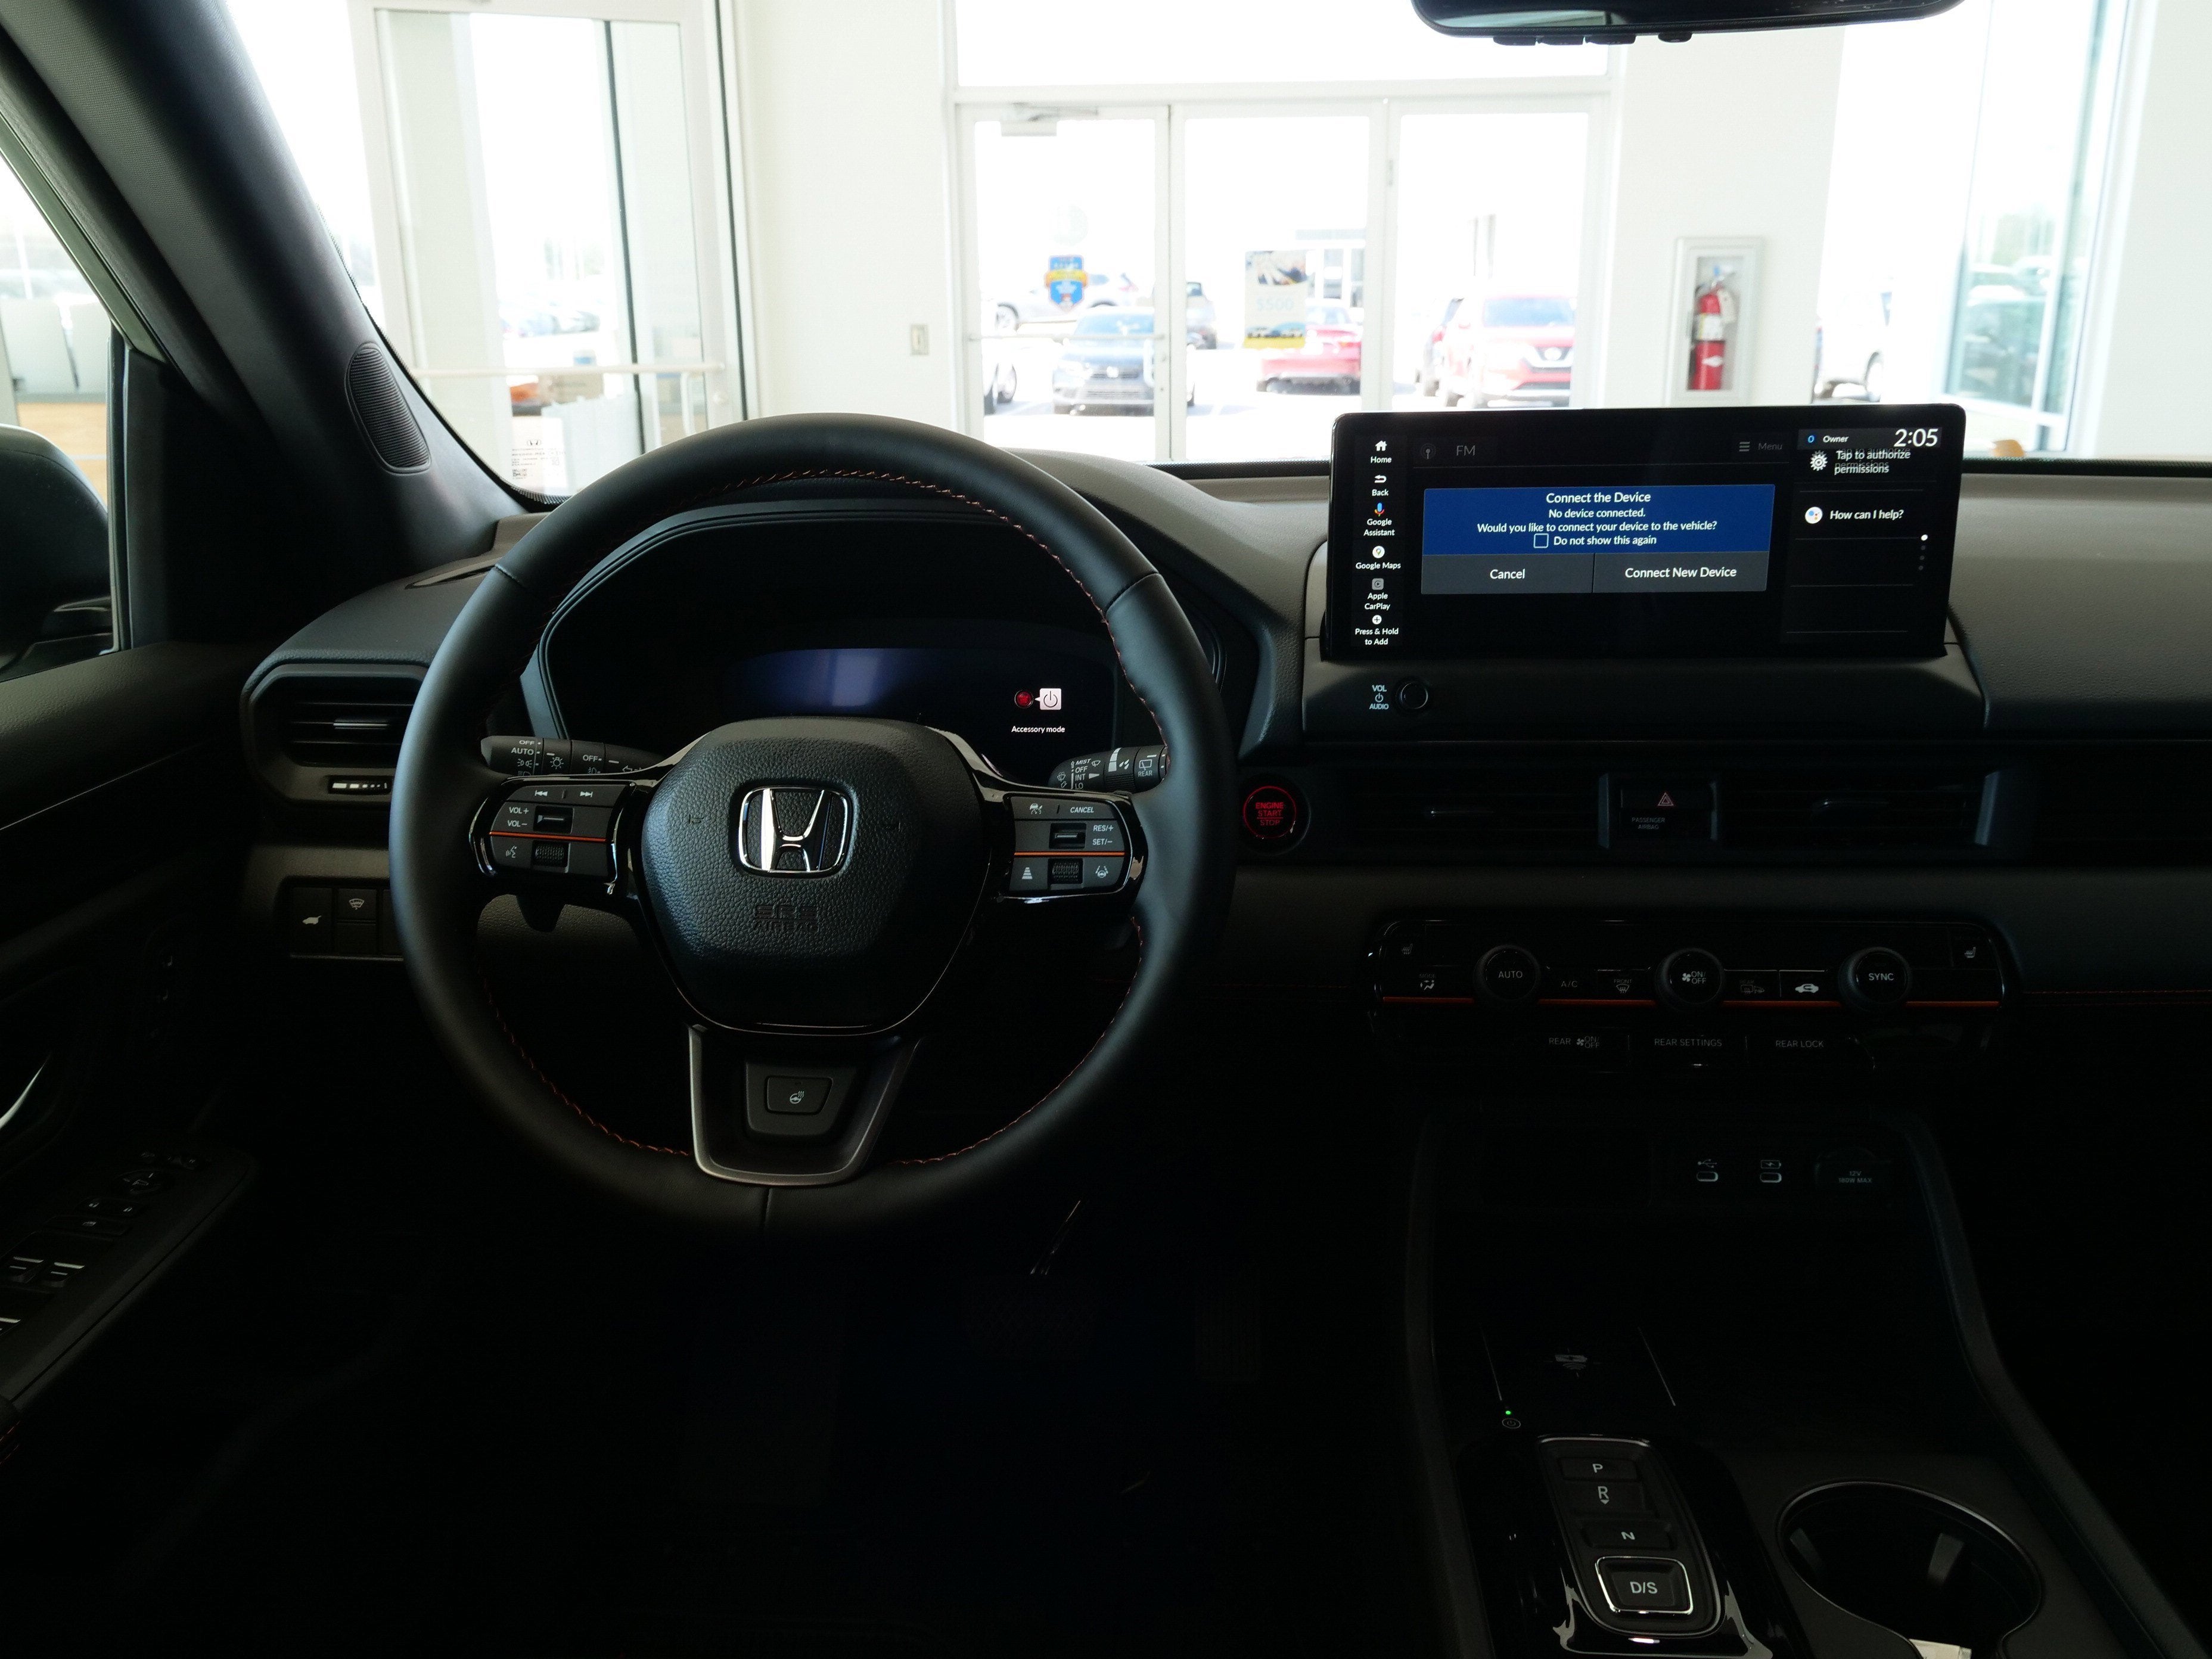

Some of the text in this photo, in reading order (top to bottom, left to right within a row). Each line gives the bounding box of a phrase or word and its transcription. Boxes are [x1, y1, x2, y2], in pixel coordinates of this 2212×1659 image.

[1894, 428, 1938, 447] 2:05
[1456, 445, 1475, 456] FM
[1758, 442, 1783, 451] Menu
[1836, 450, 1911, 461] Tap to authorize
[1834, 465, 1890, 476] permissions
[1546, 492, 1651, 504] Connect the Device
[1549, 508, 1646, 518] No device connected.
[1830, 511, 1853, 520] How
[1872, 510, 1877, 519] I
[1878, 509, 1904, 520] help?
[1477, 523, 1507, 533] Would
[1509, 525, 1526, 535] you
[1528, 523, 1544, 532] like
[1546, 524, 1556, 532] to
[1558, 523, 1594, 532] connect
[1596, 524, 1618, 533] your
[1619, 522, 1649, 531] device
[1663, 521, 1678, 530] the
[1680, 521, 1717, 530] vehicle?
[1554, 535, 1657, 545] Do not show this again
[1356, 562, 1402, 570] Google Maps
[1490, 568, 1526, 579] Cancel
[1625, 566, 1736, 578] Connect New Device
[1011, 725, 1045, 734] Accessory
[511, 747, 534, 756] AUTO
[1498, 971, 1523, 979] AUTO
[1868, 973, 1895, 981] SYNC
[1561, 980, 1578, 988] A/C
[1679, 1039, 1723, 1047] SETTINGS
[1800, 1040, 1824, 1048] LOCK
[1593, 1463, 1604, 1474] P
[1598, 1486, 1609, 1500] R
[1621, 1531, 1636, 1540] N
[1630, 1580, 1658, 1595] D/S
